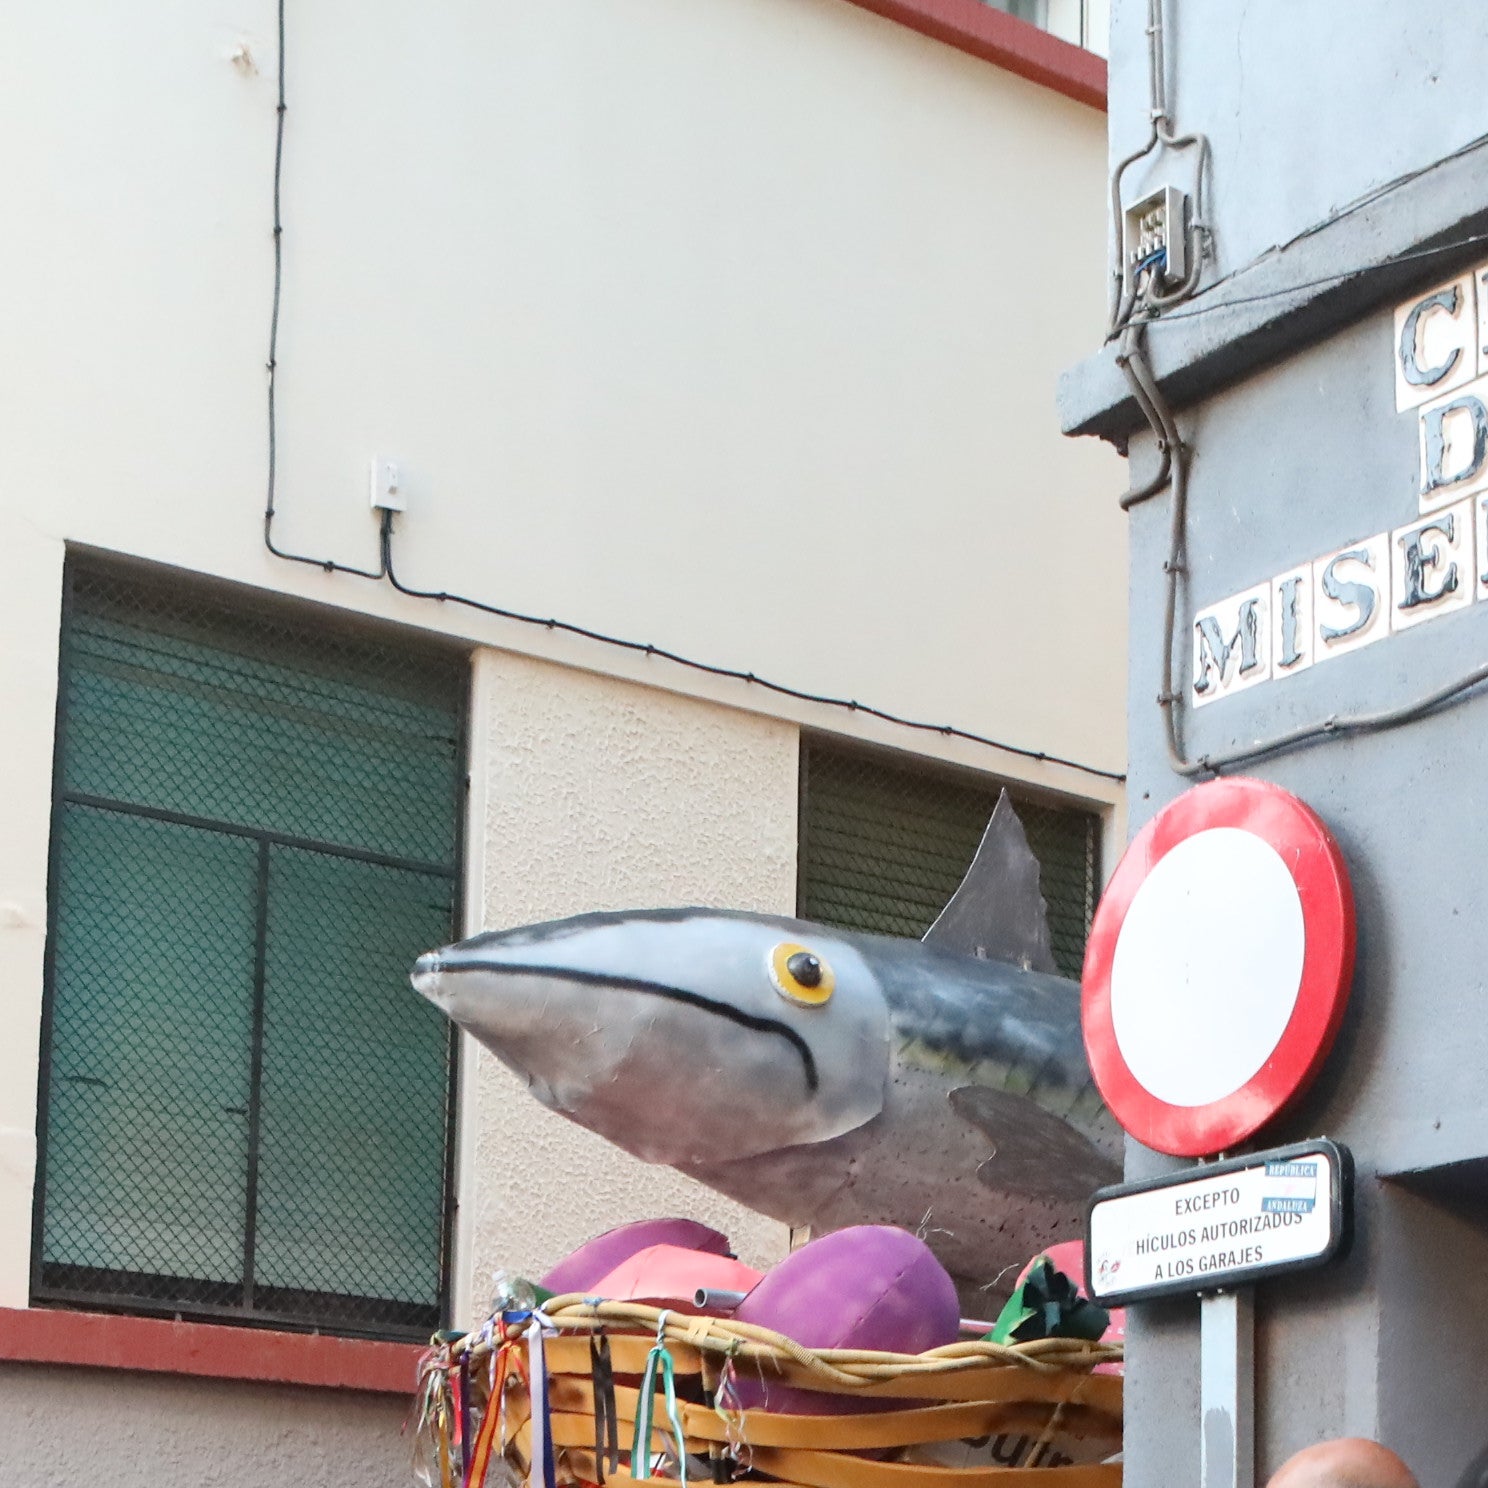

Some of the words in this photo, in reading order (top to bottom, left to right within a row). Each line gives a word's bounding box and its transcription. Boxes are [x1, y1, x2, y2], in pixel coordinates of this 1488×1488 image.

[1175, 1187, 1240, 1216] EXCEPTO
[1201, 1212, 1303, 1243] AUTORIZADOS
[1154, 1264, 1163, 1280] A
[1168, 1258, 1194, 1278] LOS
[1199, 1245, 1263, 1272] GARAJES
